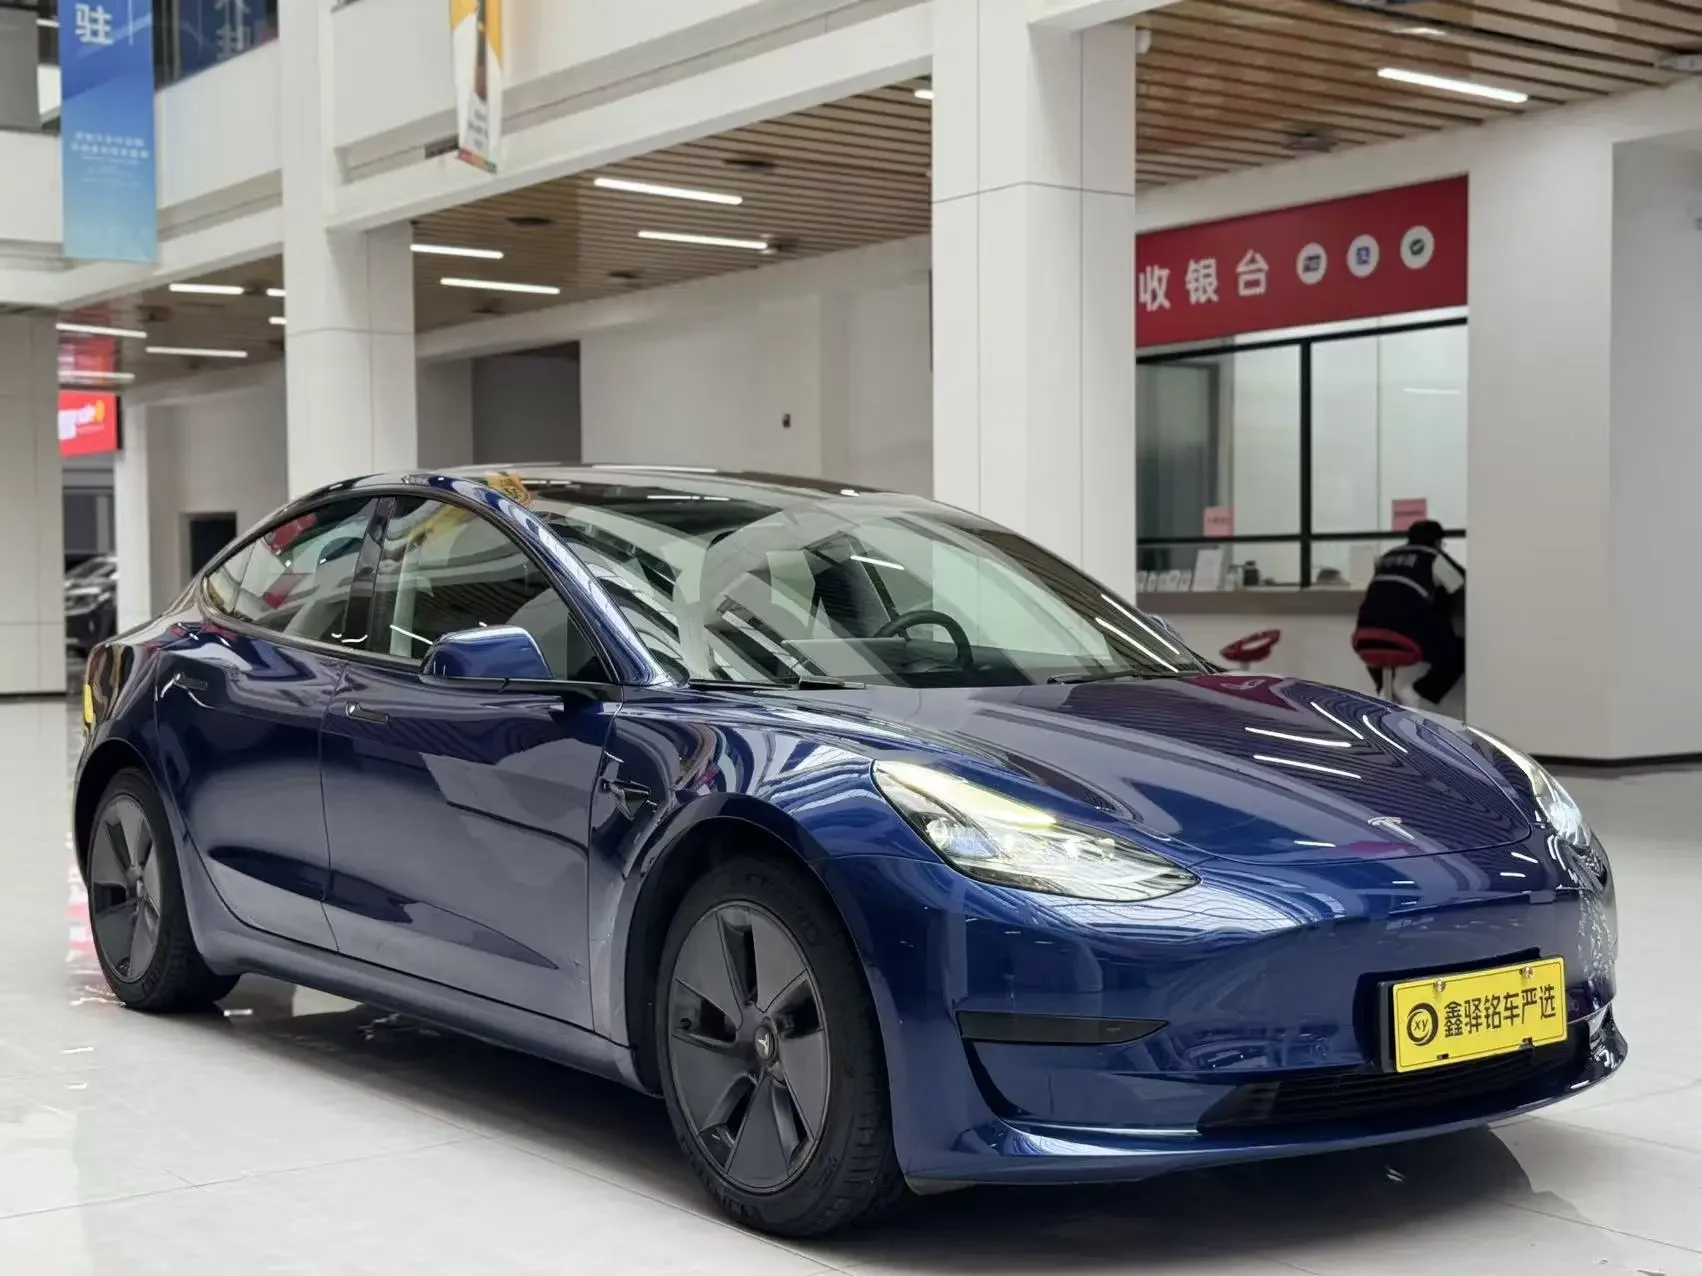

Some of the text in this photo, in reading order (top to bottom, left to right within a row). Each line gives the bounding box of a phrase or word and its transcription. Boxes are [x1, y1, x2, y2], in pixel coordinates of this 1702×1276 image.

[75, 4, 114, 46] 驻
[1139, 249, 1269, 312] 收银台
[1444, 984, 1556, 1038] 鑫驿铭车严选
